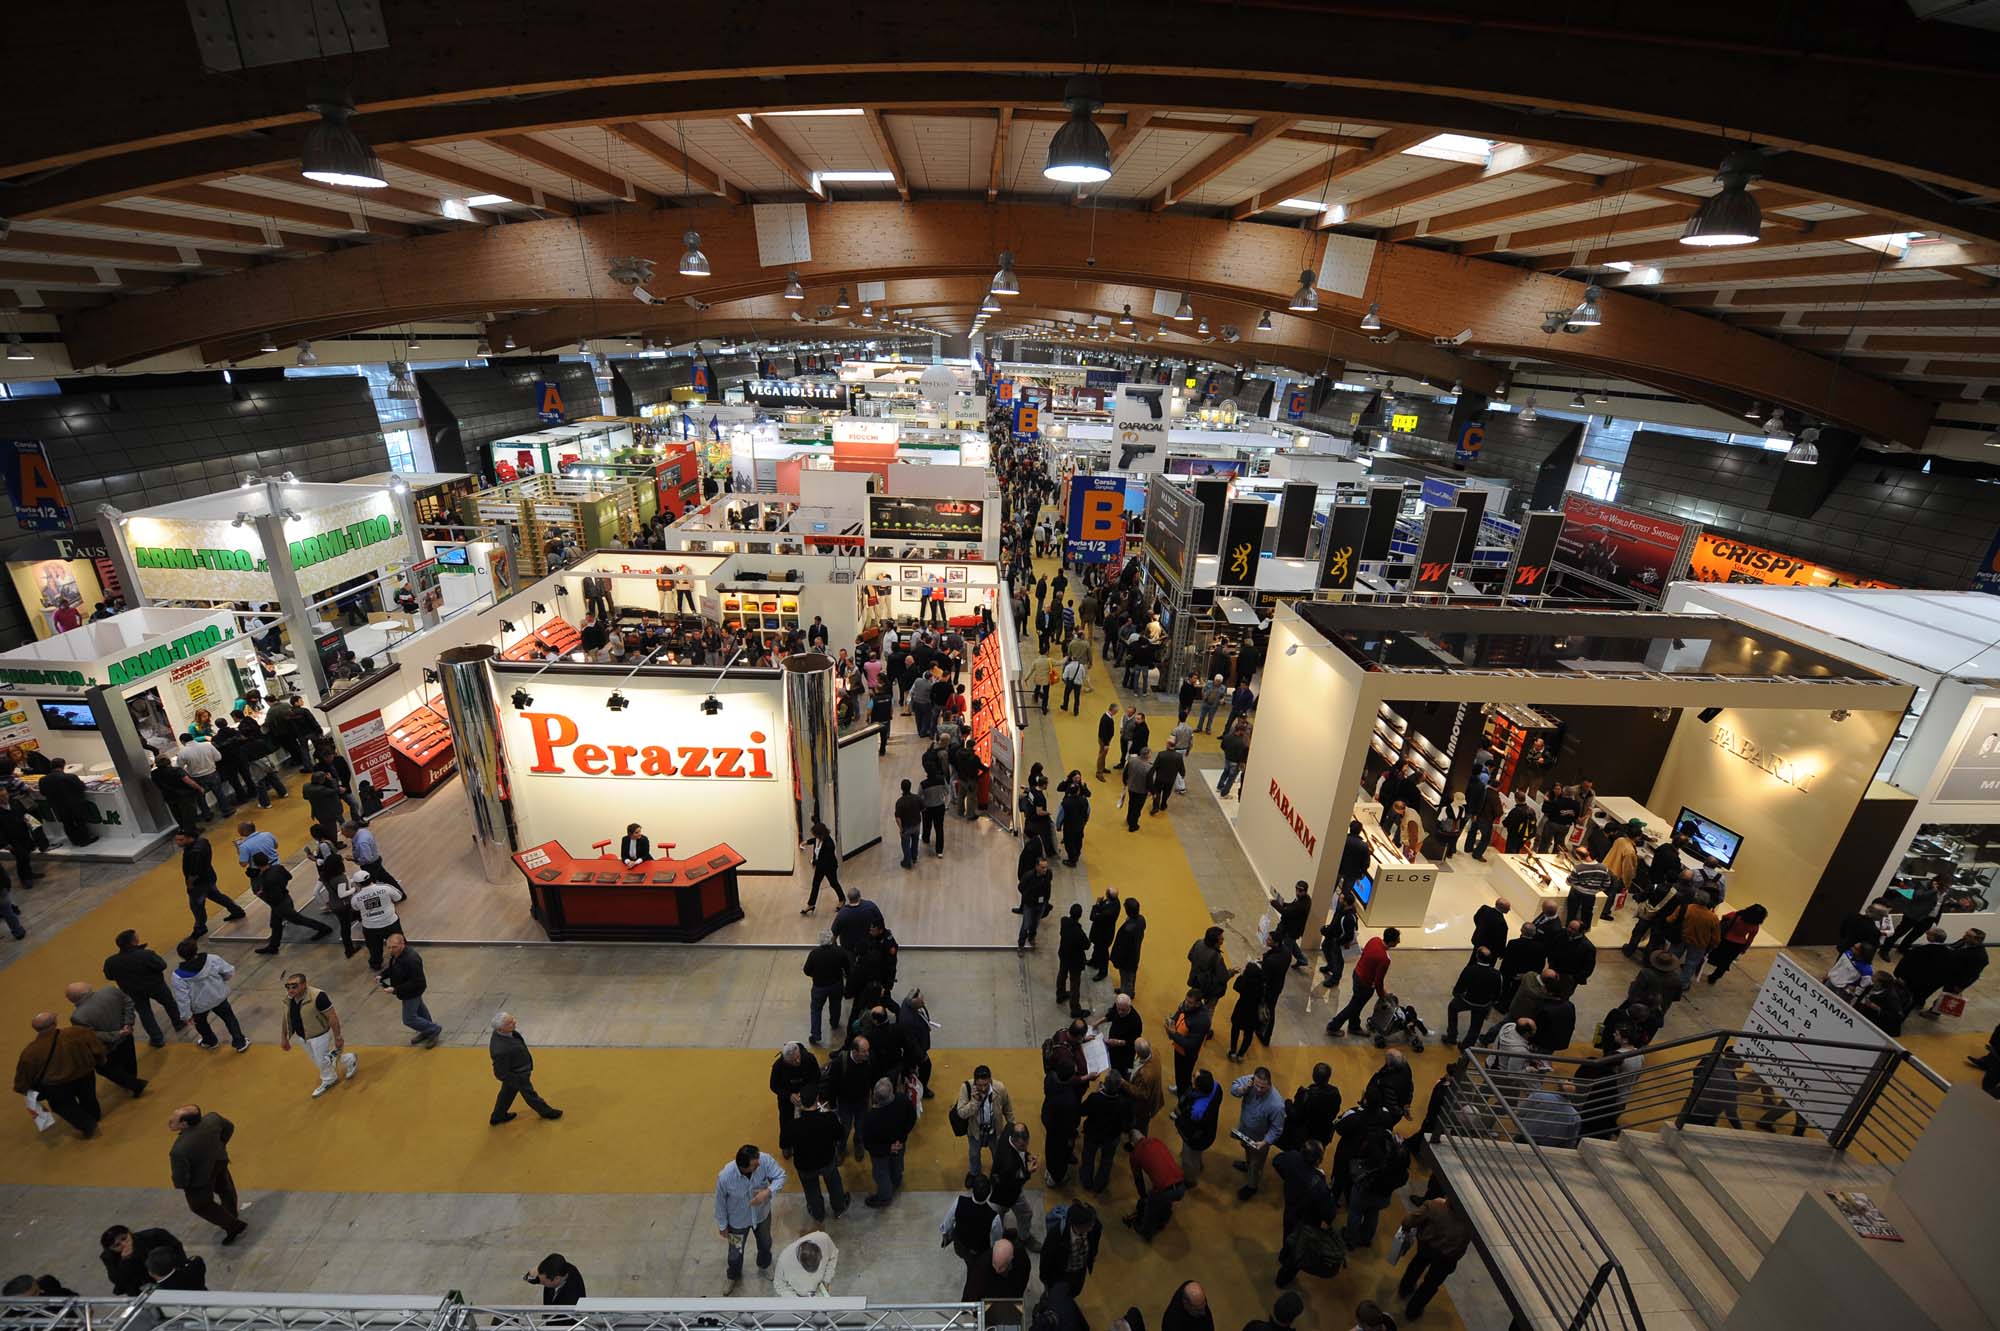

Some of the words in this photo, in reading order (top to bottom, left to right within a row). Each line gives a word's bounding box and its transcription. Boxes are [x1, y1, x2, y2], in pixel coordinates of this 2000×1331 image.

[695, 368, 707, 385] A
[544, 388, 565, 414] A
[749, 385, 780, 396] VEGA
[782, 386, 837, 399] HOLSTER
[1000, 384, 1012, 399] B
[1292, 397, 1306, 412] C
[1018, 408, 1038, 432] B
[1118, 421, 1164, 432] CARACAL
[1463, 427, 1486, 451] C
[20, 453, 66, 508] A
[1094, 478, 1117, 486] Corsia
[38, 505, 58, 518] 1/2
[1080, 490, 1126, 541] B
[1609, 513, 1629, 527] WORLD
[1628, 519, 1651, 534] FASTEST
[1651, 526, 1680, 542] SHOTGUN
[1088, 541, 1107, 552] 1/2
[1712, 541, 1804, 579] CRISPI
[520, 711, 773, 778] Perazzi
[1269, 777, 1317, 857] FABARM
[1385, 874, 1431, 882] ELOS
[1777, 980, 1801, 1005] SALA
[1810, 1008, 1818, 1018] A
[1783, 967, 1808, 991] SALA
[1809, 989, 1854, 1028] STAMPA
[1765, 1005, 1789, 1029] SALA
[1771, 993, 1796, 1017] SALA
[1803, 1020, 1812, 1029] B
